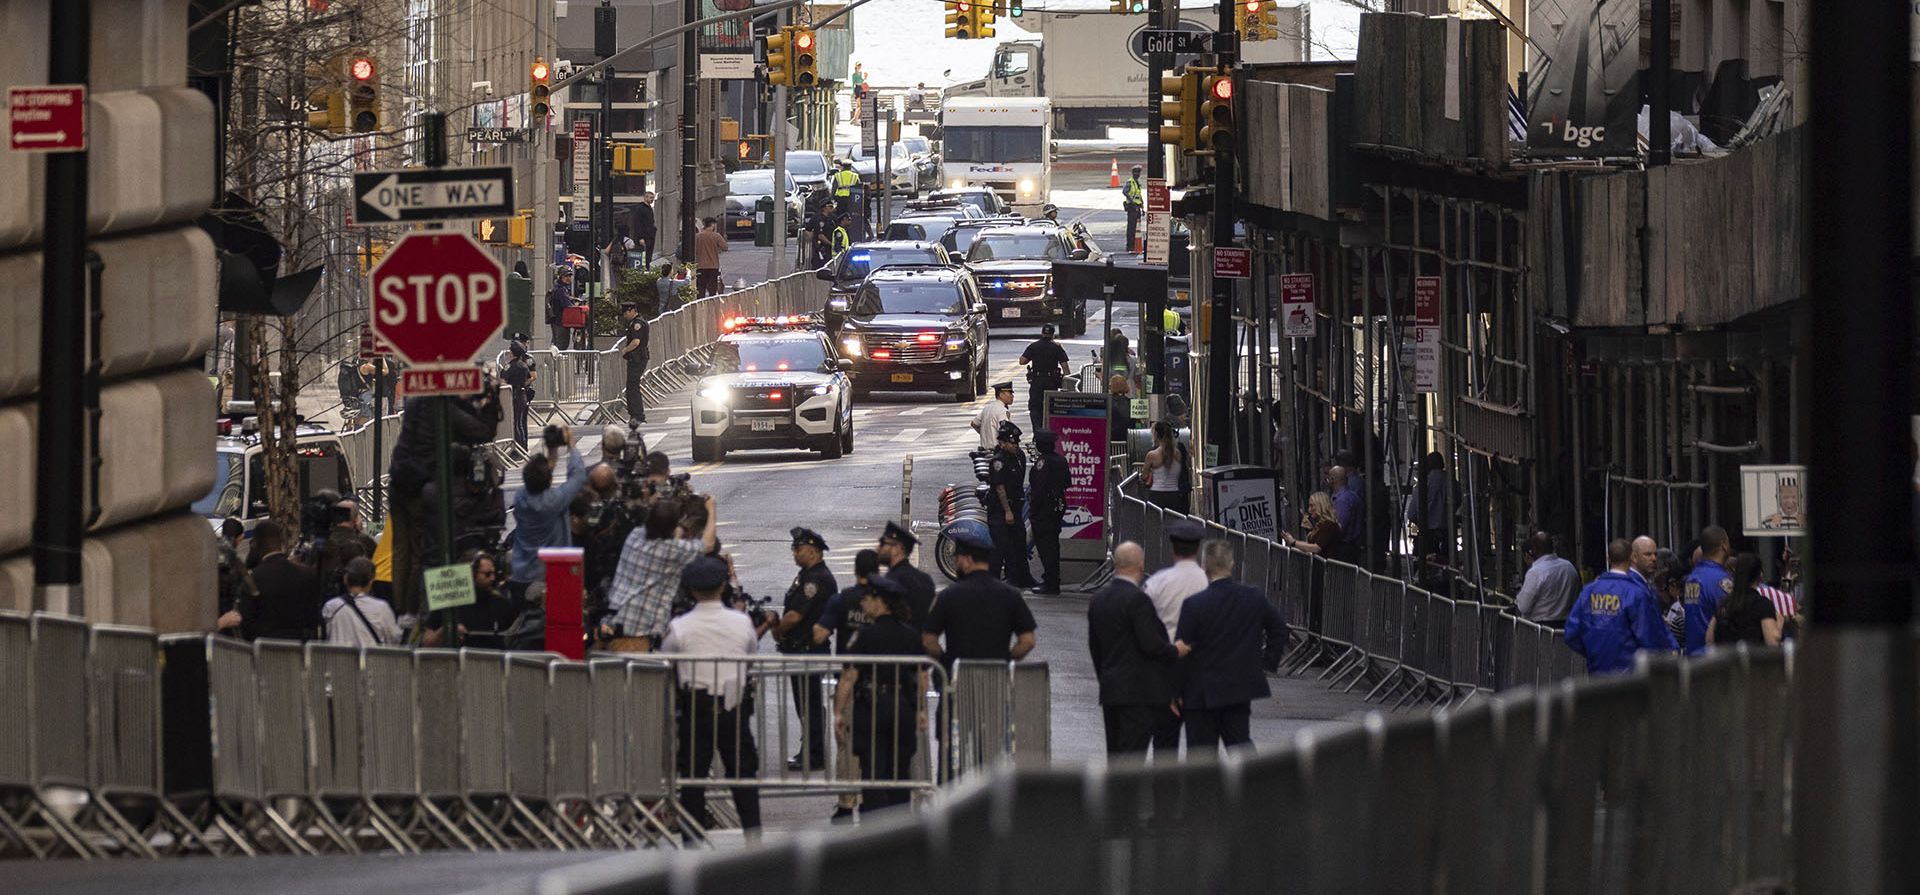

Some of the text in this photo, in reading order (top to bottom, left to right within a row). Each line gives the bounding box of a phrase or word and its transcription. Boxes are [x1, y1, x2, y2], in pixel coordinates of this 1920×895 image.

[1147, 35, 1186, 53] Gold St
[26, 94, 73, 107] STOPPING
[469, 130, 507, 141] PEARL
[1562, 119, 1605, 148] bgc
[969, 166, 1014, 174] FedEx
[377, 182, 494, 208] ONE WAY
[855, 194, 861, 203] P
[1148, 213, 1154, 224] 3
[1224, 250, 1246, 258] STANDING
[634, 259, 641, 269] P
[379, 273, 497, 325] STOP
[1416, 329, 1424, 342] 3
[1172, 356, 1181, 369] P
[407, 372, 475, 391] ALL WAY
[1062, 427, 1092, 435] lyft rentals
[1061, 440, 1092, 454] Wait,
[1065, 453, 1101, 464] ft has
[1069, 464, 1095, 475] ntal
[1071, 476, 1093, 486] rs?
[1239, 501, 1271, 522] DINE
[1241, 518, 1273, 532] AROUND
[440, 568, 455, 578] NO
[1591, 593, 1620, 612] NYPD
